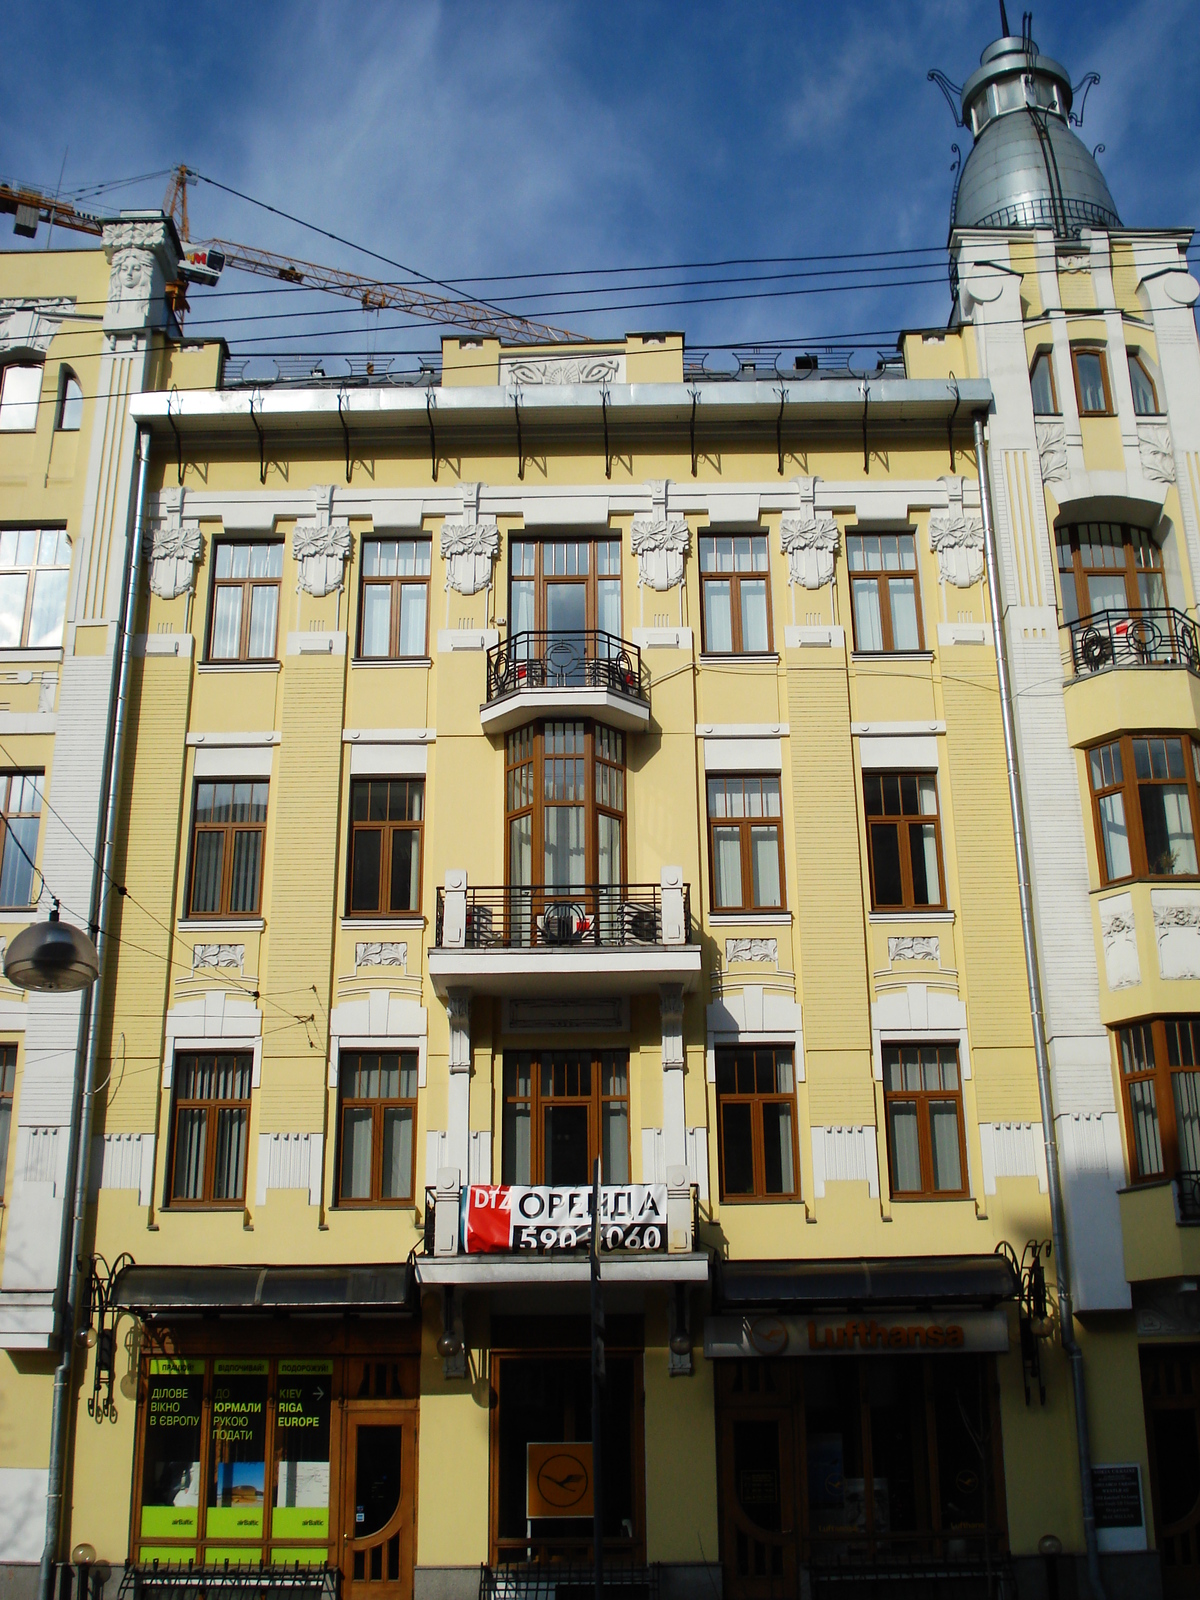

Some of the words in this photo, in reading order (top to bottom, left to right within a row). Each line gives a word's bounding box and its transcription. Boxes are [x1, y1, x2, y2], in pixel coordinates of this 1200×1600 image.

[474, 1186, 511, 1210] DTZ
[518, 1190, 660, 1220] ОРЕНДА
[520, 1227, 577, 1249] 590
[587, 1226, 661, 1249] 060
[807, 1320, 964, 1349] Lufthansa
[218, 1363, 265, 1372] ВІДПОЧИВАЙ!
[281, 1363, 329, 1373] ПОДОРОЖУЙ!
[151, 1388, 188, 1400] ДІЛОВЕ
[215, 1388, 230, 1400] ДО
[279, 1389, 302, 1399] KIEV
[150, 1402, 180, 1412] ВІКНО
[214, 1402, 262, 1413] ЮРМАЛИ
[278, 1402, 303, 1413] RIGA
[149, 1415, 157, 1426] В
[159, 1415, 200, 1427] ЄВРОПУ
[213, 1416, 249, 1427] РУКОЮ
[278, 1416, 320, 1427] EUROPE
[212, 1429, 253, 1442] ПОДАТИ
[171, 1518, 193, 1526] airBaltic
